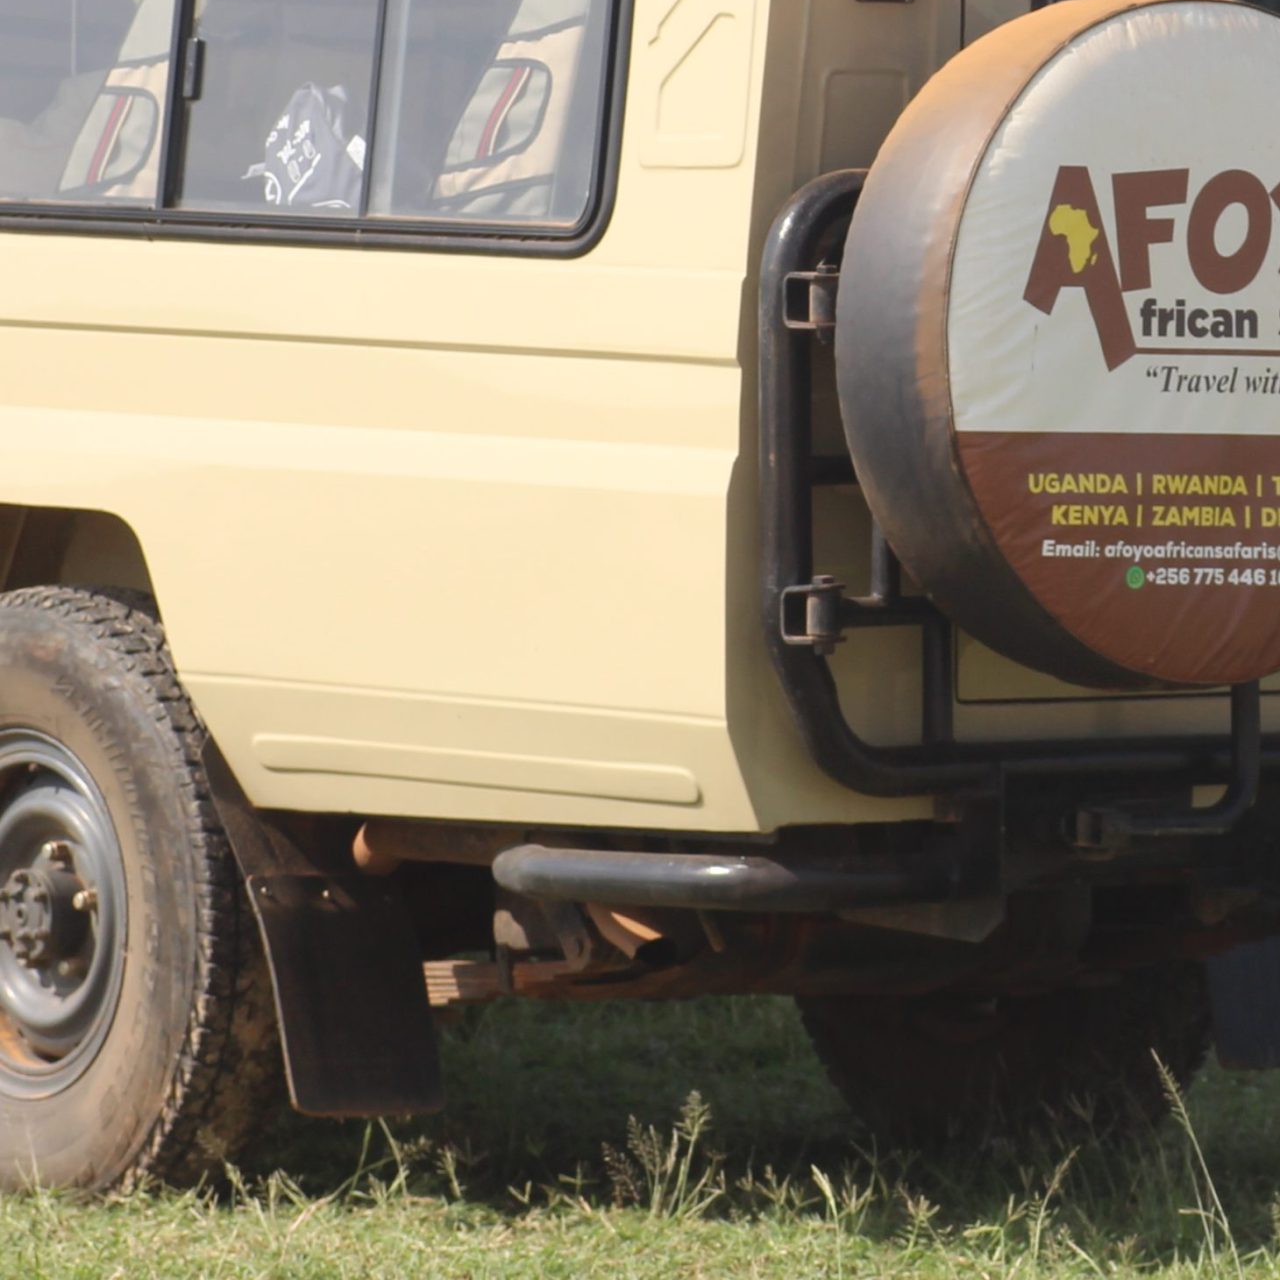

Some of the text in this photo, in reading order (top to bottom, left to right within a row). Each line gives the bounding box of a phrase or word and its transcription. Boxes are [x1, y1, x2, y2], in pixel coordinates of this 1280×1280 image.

[1028, 473, 1128, 494] UGANDA
[1152, 474, 1248, 496] RWANDA
[1051, 505, 1129, 526] KENYA
[1151, 506, 1236, 526] ZAMBIA
[1042, 540, 1100, 558] Email:
[1146, 568, 1190, 585] +256
[1193, 569, 1224, 585] 775
[1228, 569, 1266, 586] 446
